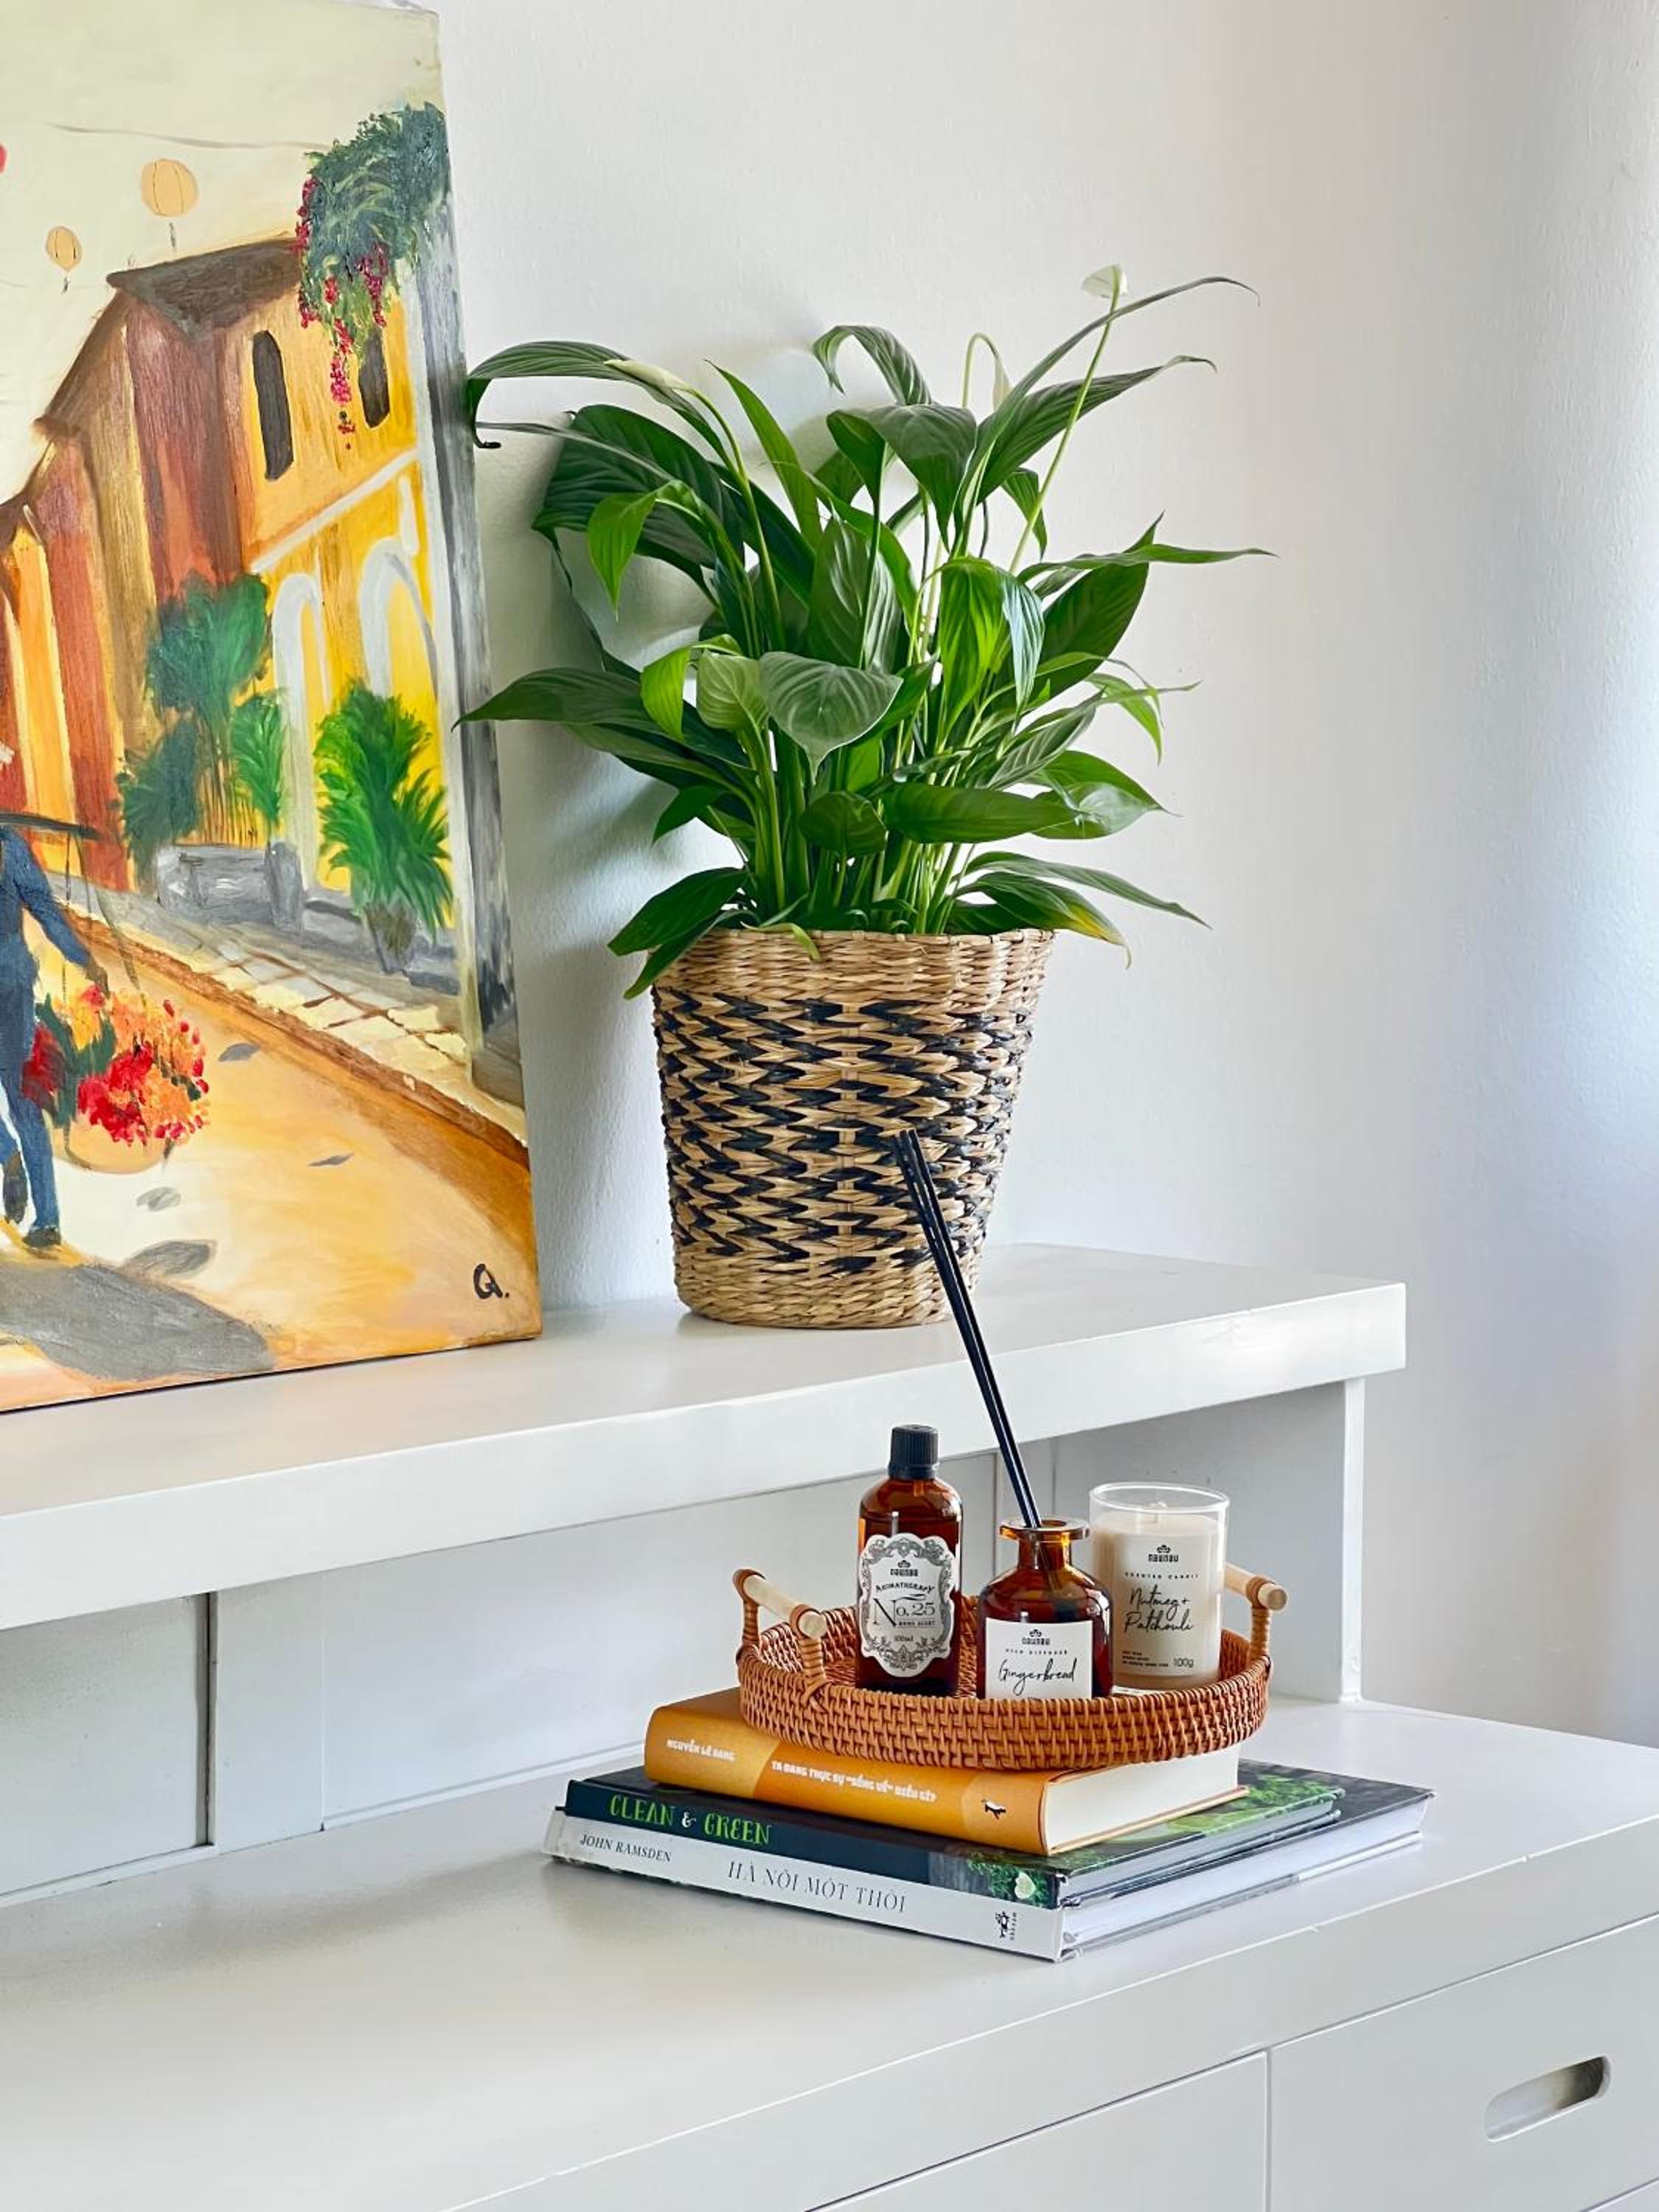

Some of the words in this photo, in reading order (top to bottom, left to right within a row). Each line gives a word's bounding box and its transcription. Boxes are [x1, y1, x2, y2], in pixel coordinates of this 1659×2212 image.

[609, 1793, 675, 1827] CLEAN
[681, 1811, 697, 1829] &
[703, 1812, 773, 1845] GREEN
[580, 1834, 613, 1851] JOHN
[615, 1840, 672, 1863] RAMSDEN
